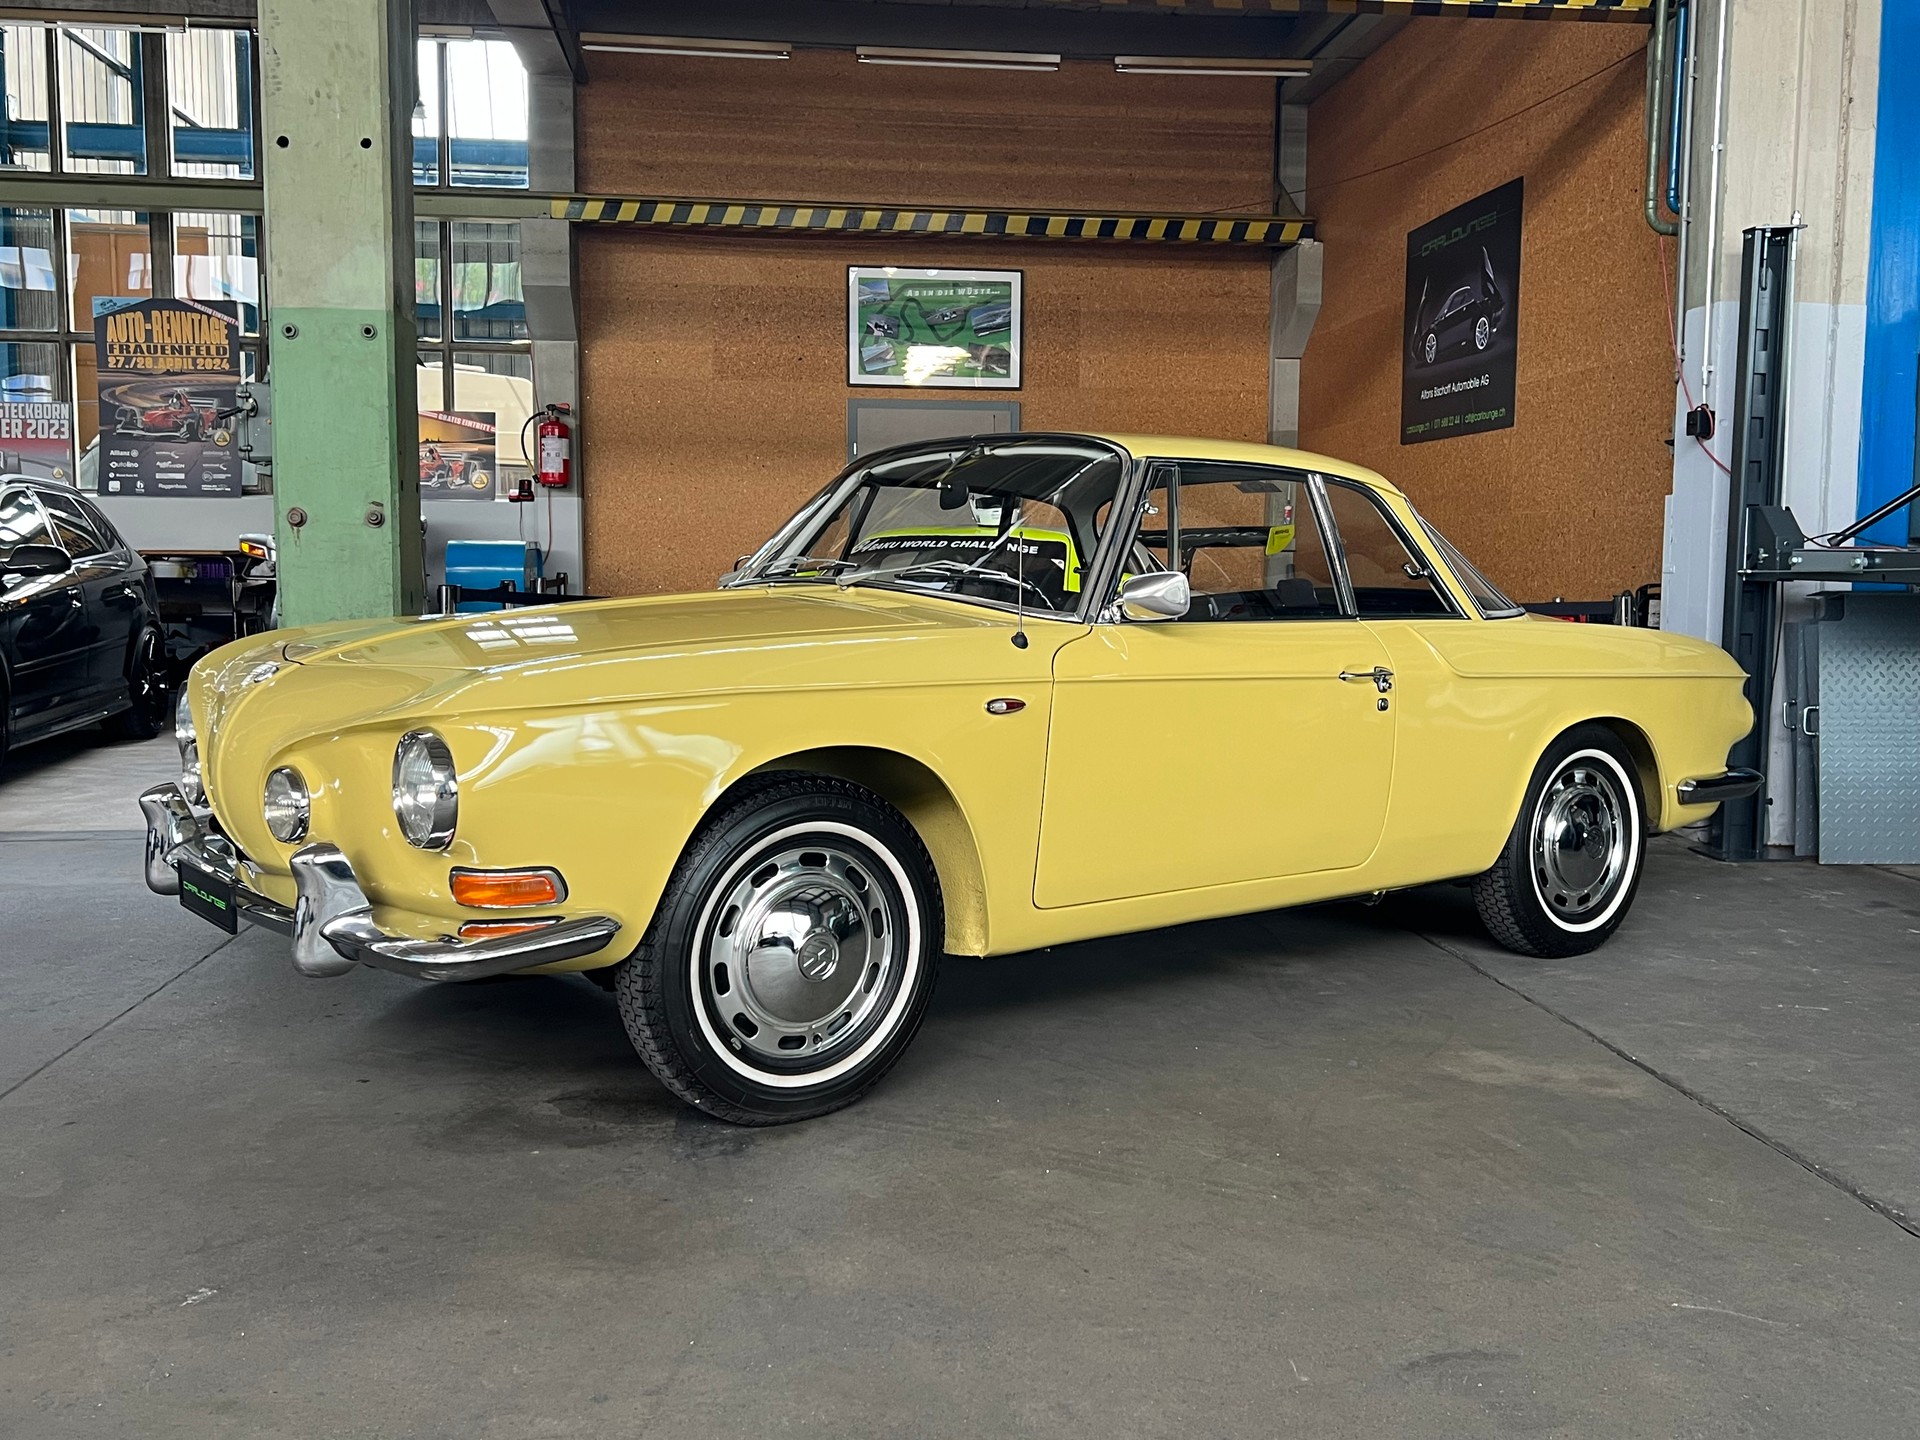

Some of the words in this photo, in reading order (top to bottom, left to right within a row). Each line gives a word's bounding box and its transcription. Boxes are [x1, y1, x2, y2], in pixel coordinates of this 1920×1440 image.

[107, 310, 229, 345] AUTO-RENNTAGE
[108, 344, 228, 357] FRAUENFELD
[196, 357, 230, 371] 2024
[1451, 377, 1480, 393] Automobile
[1480, 374, 1490, 387] AG
[26, 419, 70, 439] 2023
[438, 413, 462, 426] GRATIS
[461, 419, 491, 432] EINTRITT
[900, 540, 948, 548] WORLD
